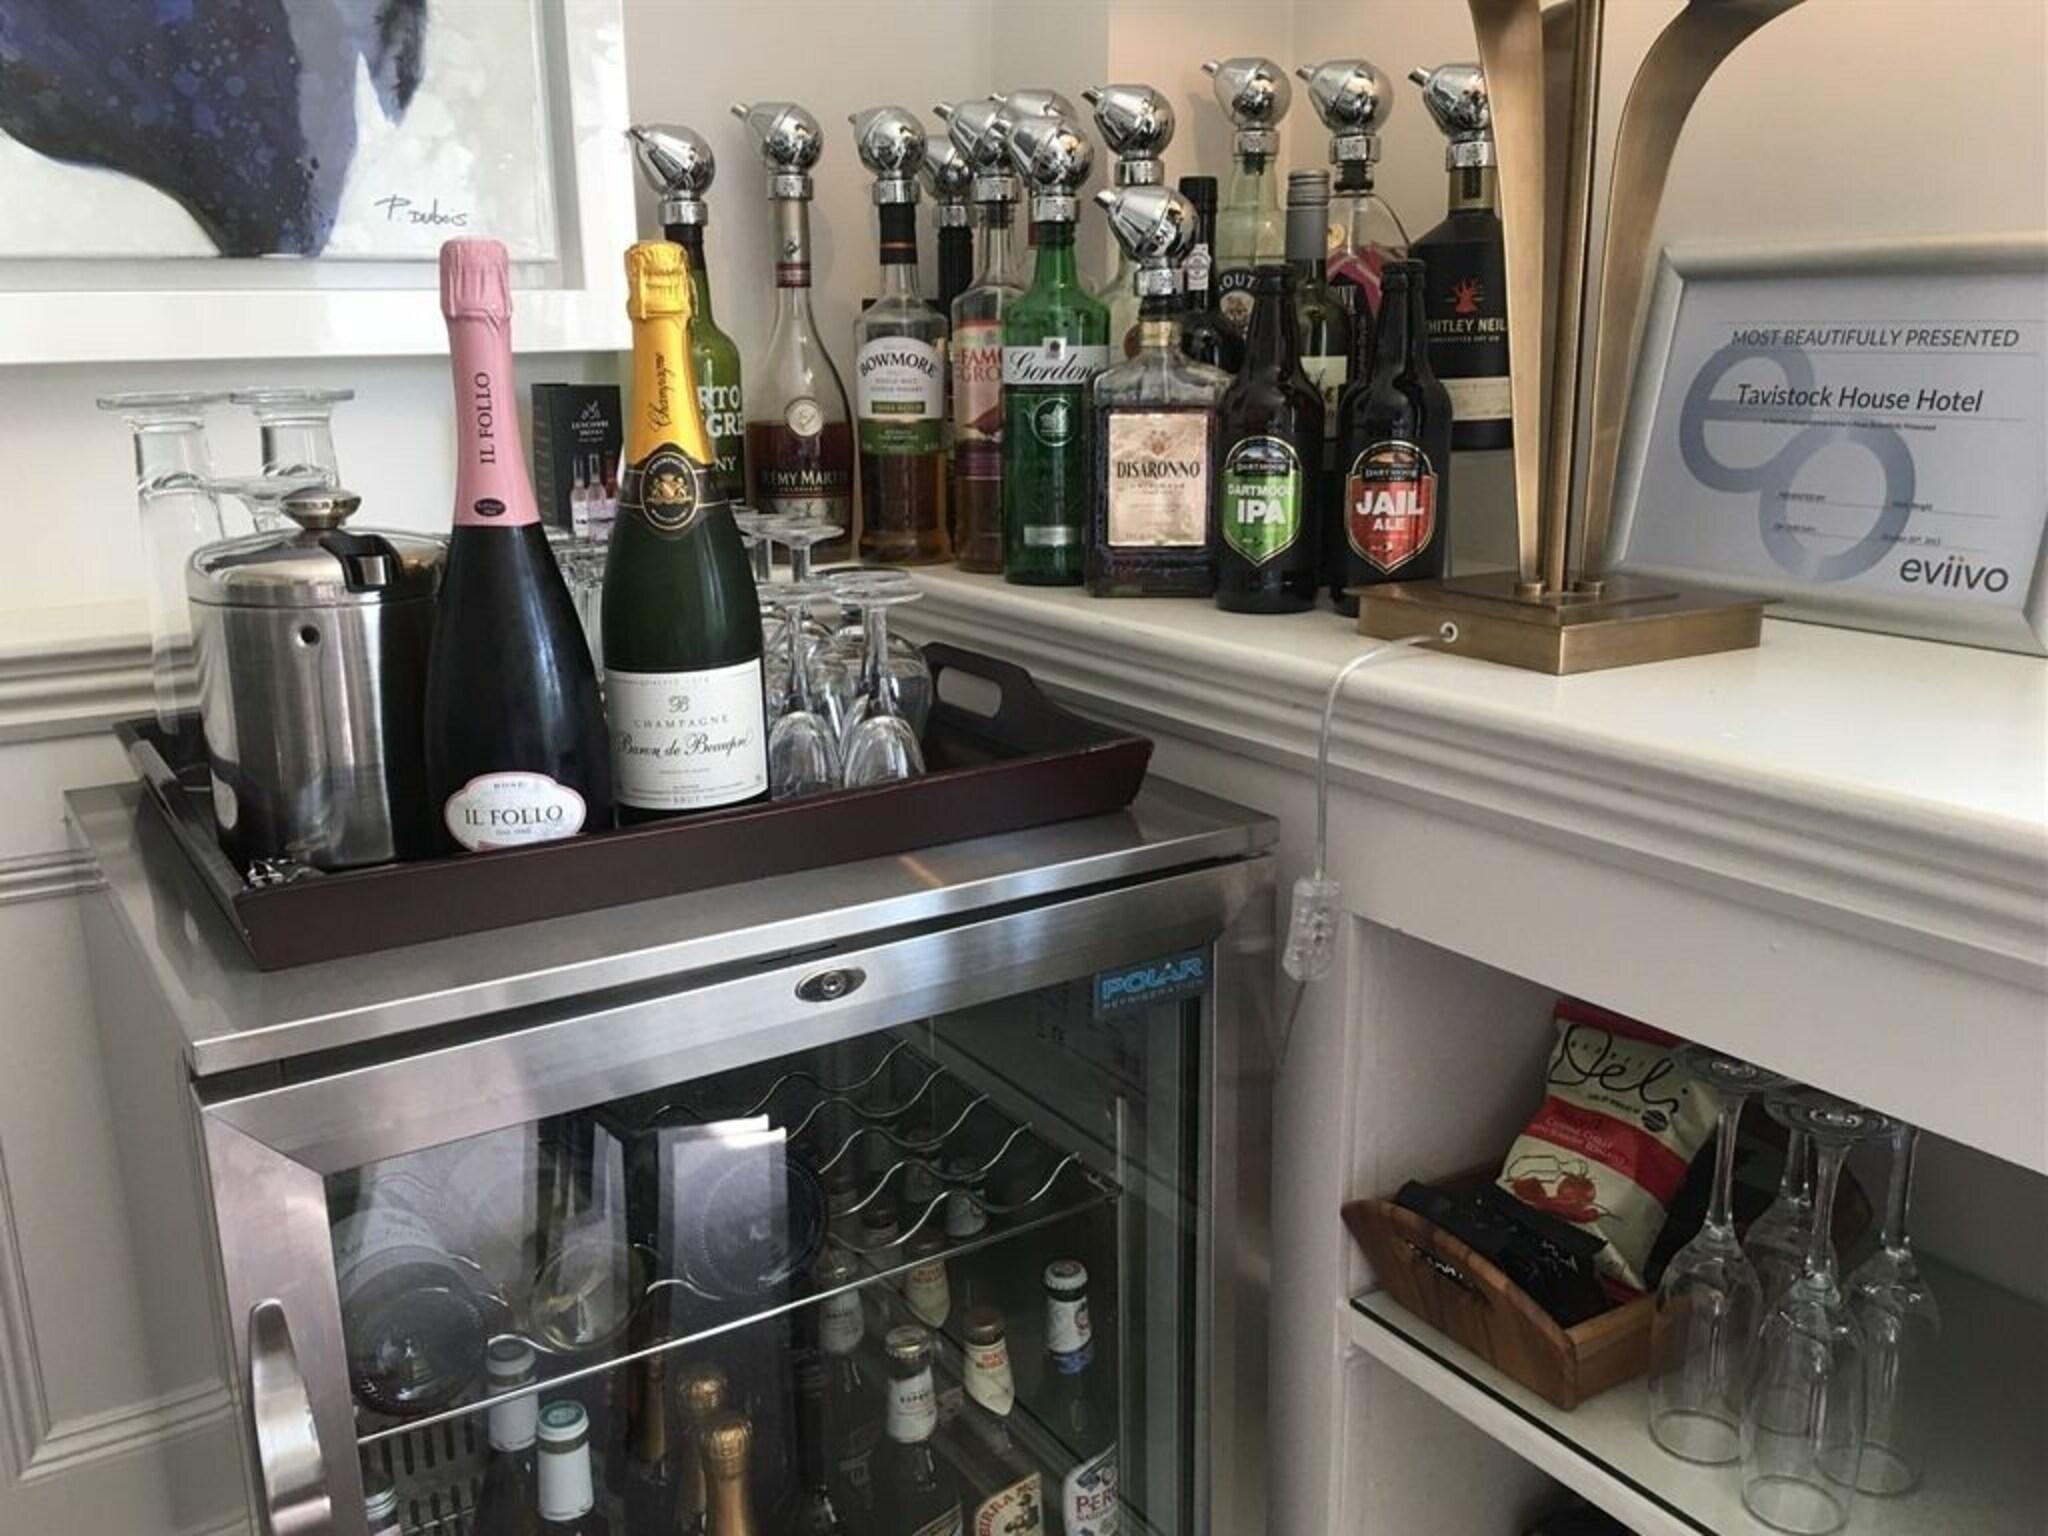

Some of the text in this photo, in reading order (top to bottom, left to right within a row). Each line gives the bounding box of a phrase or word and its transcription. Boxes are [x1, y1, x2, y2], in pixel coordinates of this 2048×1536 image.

[1425, 318, 1506, 333] HITLEY NEIL
[1731, 328, 2020, 348] MOST BEAUTIFULLY PRESENTED
[860, 351, 938, 379] BOWMORE
[697, 384, 741, 410] RTO
[1737, 383, 1984, 413] Tavistock House Hotel
[474, 372, 496, 464] IL FOLLO
[706, 411, 745, 438] GRE
[1117, 461, 1201, 480] DISARONNO
[1237, 498, 1287, 525] IPA
[1355, 490, 1425, 516] JAIL
[1373, 517, 1406, 531] ALE
[1899, 554, 2009, 593] eviivo
[633, 714, 729, 729] CHAMPAGNE
[664, 738, 681, 756] de
[465, 804, 564, 827] IL FOLLO
[1102, 956, 1203, 1000] POLAR
